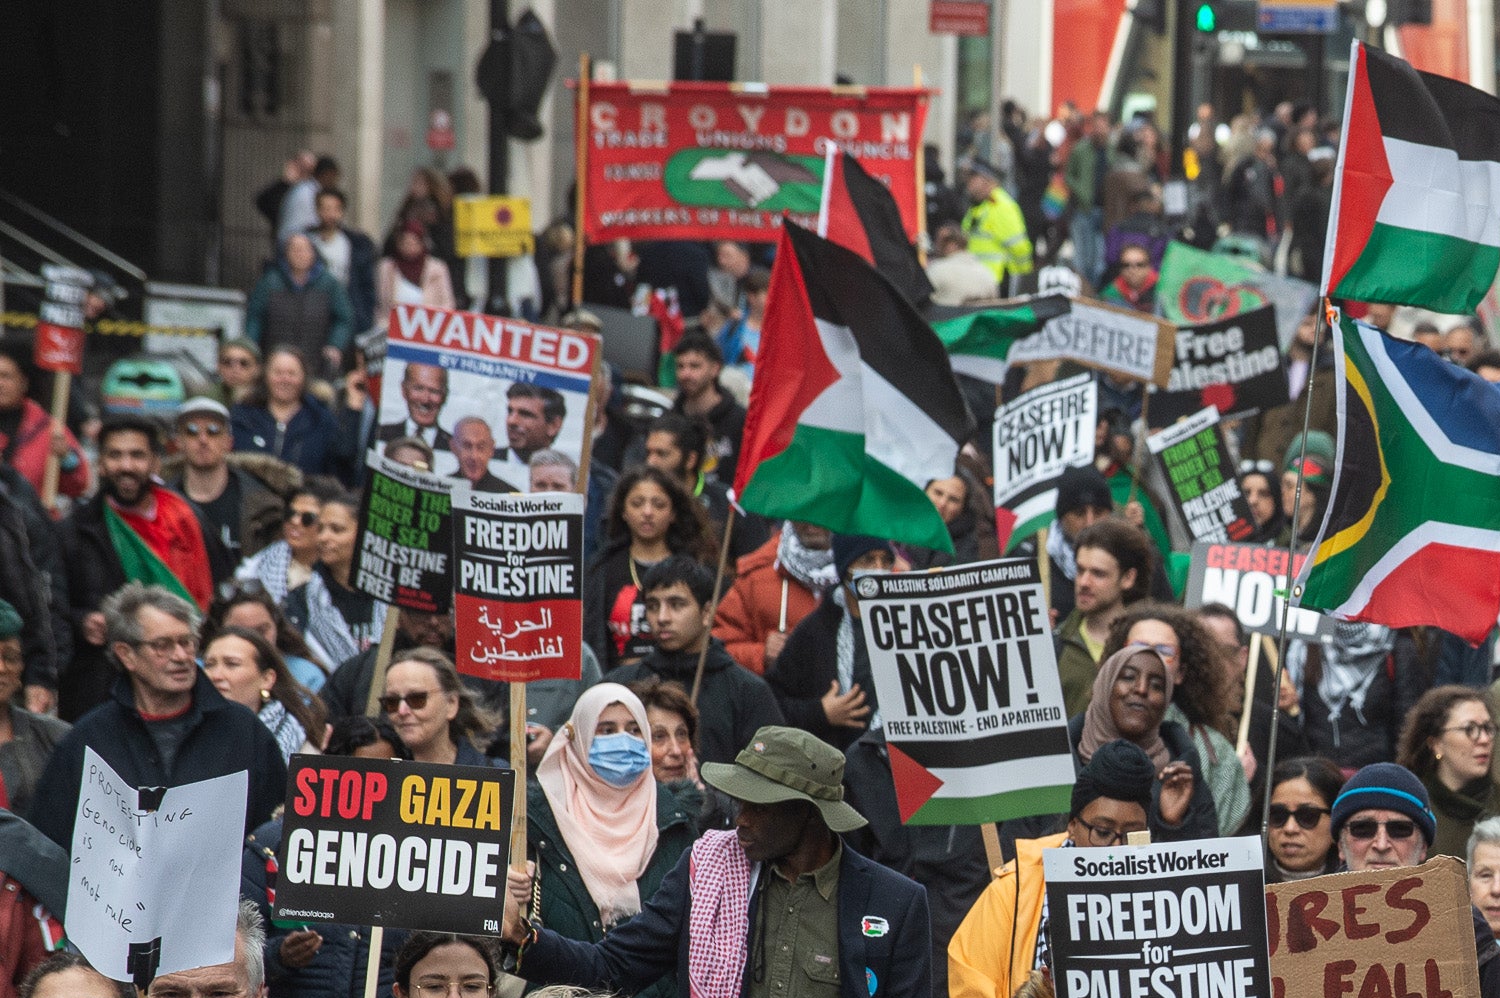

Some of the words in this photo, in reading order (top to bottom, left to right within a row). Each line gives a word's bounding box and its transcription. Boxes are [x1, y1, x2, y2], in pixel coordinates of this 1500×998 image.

[590, 102, 910, 142] CROYDON
[593, 130, 668, 149] TRADE
[696, 131, 787, 153] UNIONS
[813, 136, 912, 160] CUNCIL
[397, 305, 590, 370] WANTED
[1018, 314, 1153, 369] ASEFIRE
[1176, 326, 1245, 359] Free
[438, 353, 456, 368] BY
[458, 356, 538, 383] HUMANITY
[1167, 345, 1279, 392] alestine
[999, 388, 1089, 448] CEASEFIRE
[1008, 419, 1080, 482] NOW!
[1196, 427, 1218, 450] THE
[1203, 447, 1221, 469] TO
[372, 471, 417, 501] FROM
[420, 491, 451, 515] THE
[1201, 467, 1224, 491] SEA
[369, 495, 414, 526] RIVER
[418, 512, 441, 532] TO
[1182, 478, 1242, 521] PALESTINE
[1219, 502, 1238, 525] BE
[367, 512, 392, 539] THE
[397, 526, 430, 550] SEA
[464, 515, 569, 552] FREEDOM
[359, 549, 395, 583] WILL
[398, 566, 424, 590] BE
[363, 530, 448, 575] PALESTINE
[506, 551, 526, 567] for
[1206, 543, 1308, 579] CEASEF
[356, 571, 395, 602] FREE
[460, 559, 575, 597] PALESTINE
[882, 577, 929, 594] PALESTINE
[928, 571, 982, 591] SOLIDARITY
[980, 564, 1032, 585] CAMPAIGN
[477, 605, 553, 638] الحرية
[869, 588, 1044, 651] CEASEFIRE
[470, 635, 565, 665] لفلسطين
[887, 720, 913, 736] FREE
[914, 719, 967, 736] PALESTINE
[976, 714, 999, 732] END
[1001, 705, 1062, 727] APARTHEID
[88, 764, 194, 828] PROTESTING
[293, 767, 389, 821] STOP
[399, 774, 502, 831] GAZA
[82, 832, 93, 850] is
[109, 858, 124, 877] not
[285, 827, 501, 899] GENOCIDE
[278, 907, 335, 920] @friendsofalaqsa
[483, 919, 499, 932] FOA
[1066, 882, 1242, 942] FREEDOM
[1141, 940, 1172, 966] for
